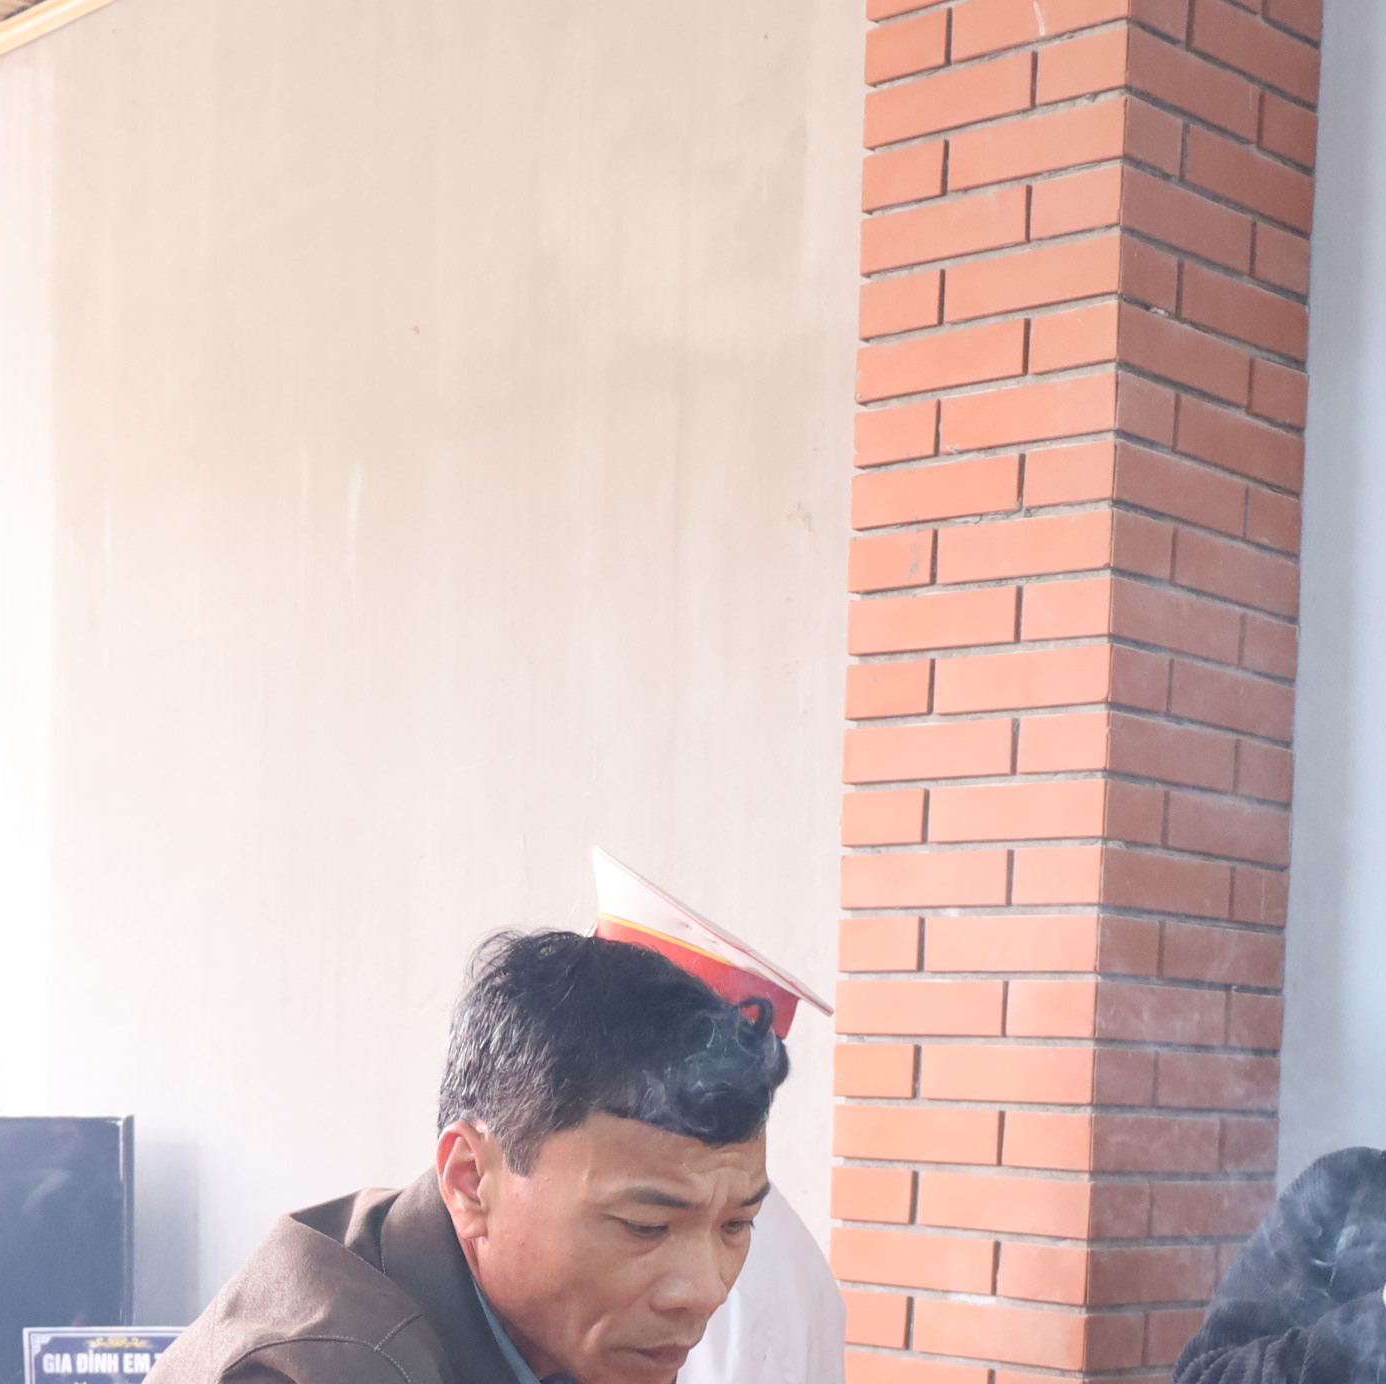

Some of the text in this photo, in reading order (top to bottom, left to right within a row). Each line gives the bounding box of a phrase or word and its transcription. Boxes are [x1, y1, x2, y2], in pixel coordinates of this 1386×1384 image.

[43, 1348, 151, 1374] GIA ĐÌNH EM
